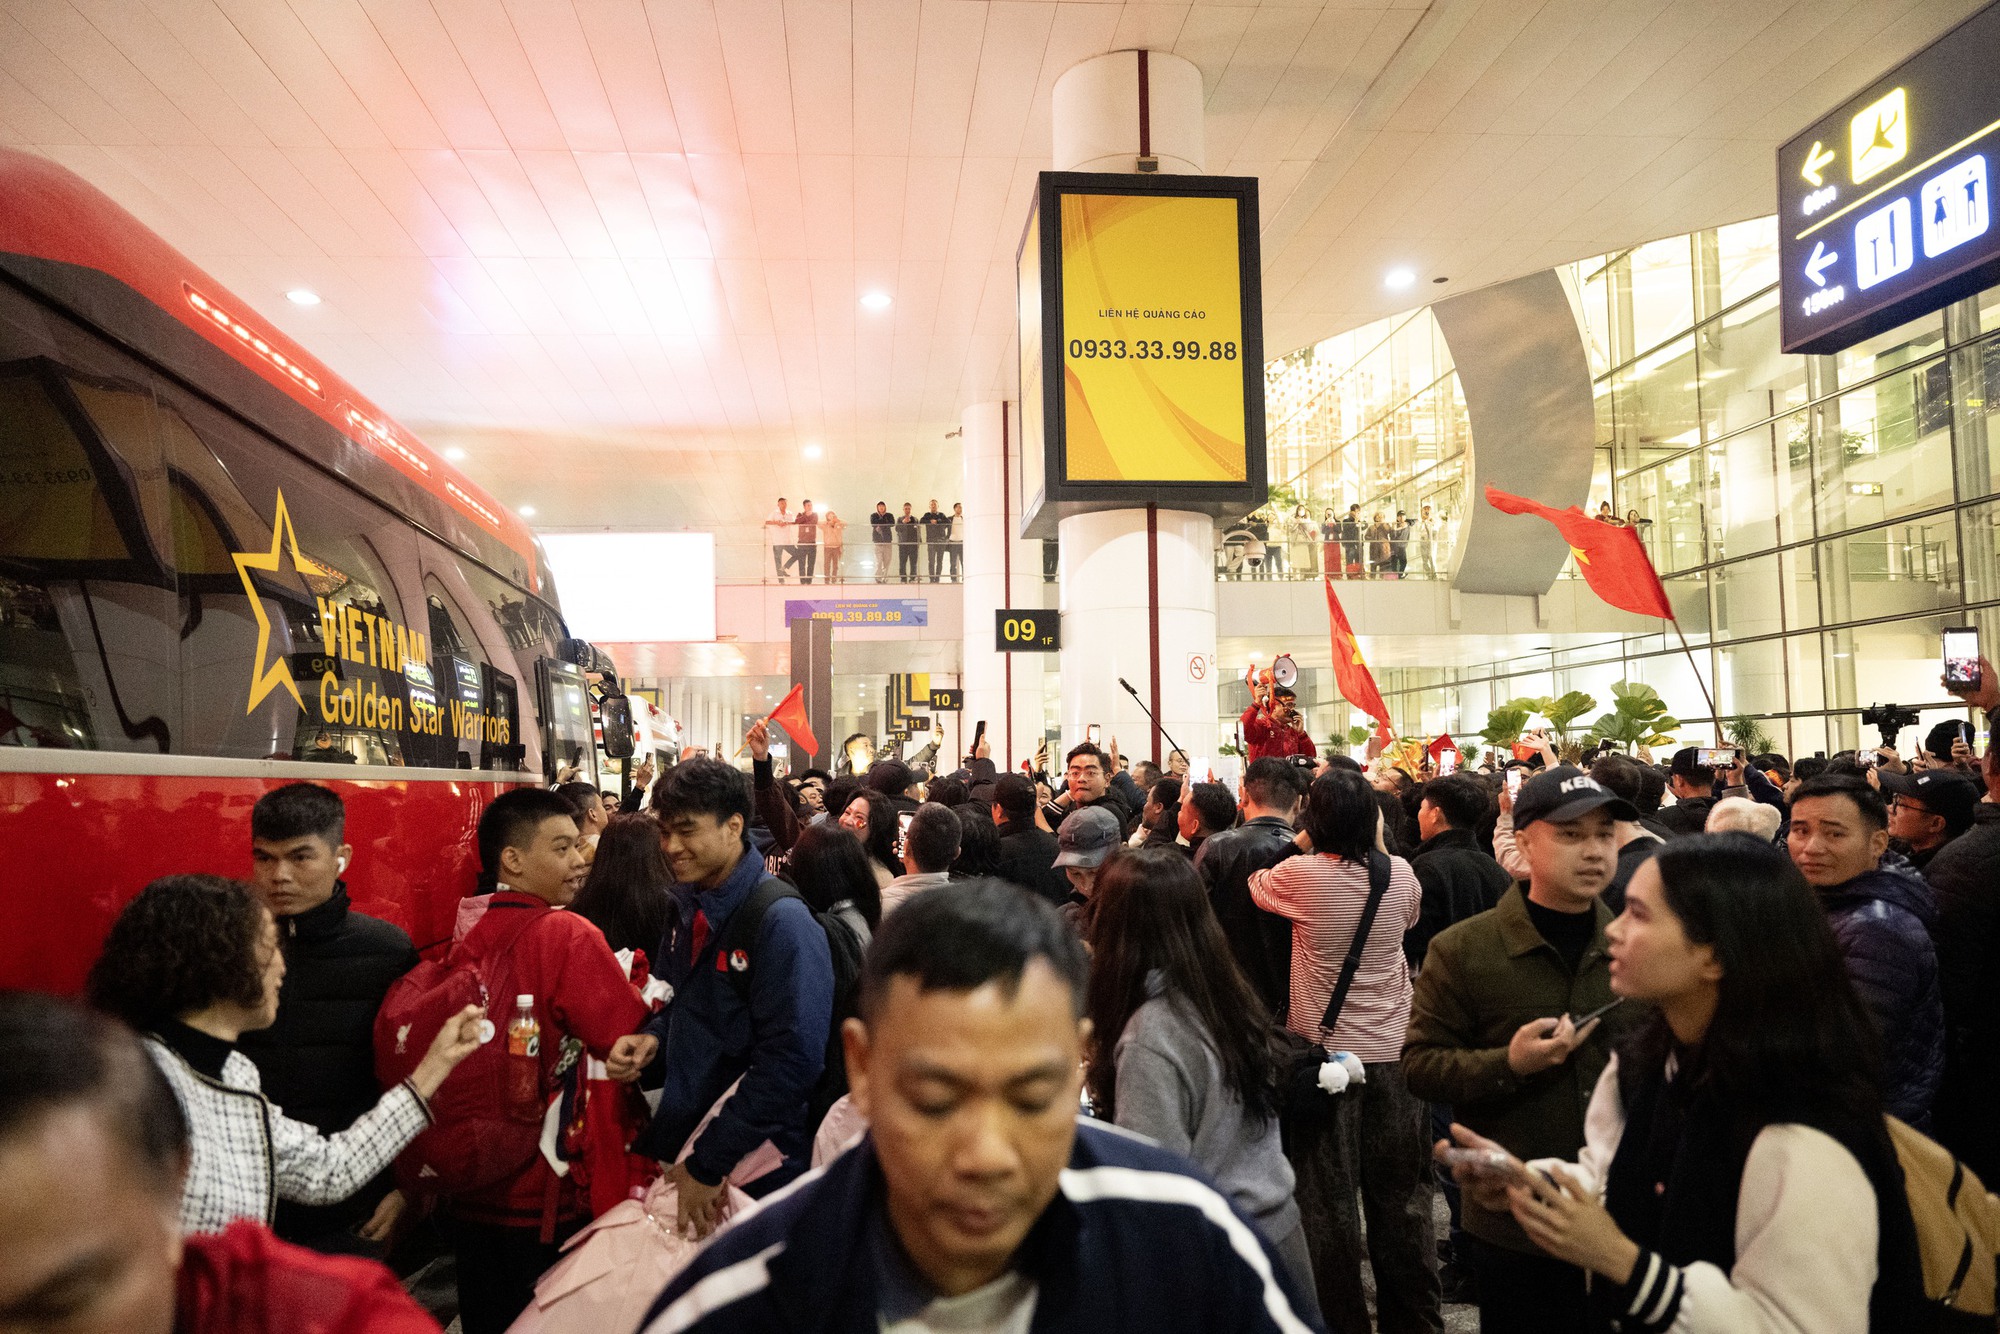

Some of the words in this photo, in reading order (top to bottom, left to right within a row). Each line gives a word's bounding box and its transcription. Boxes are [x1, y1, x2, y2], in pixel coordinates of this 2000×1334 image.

[1098, 308, 1122, 318] LIÊN
[1125, 308, 1140, 320] HỆ
[1143, 307, 1180, 319] QUẢNG
[1183, 308, 1206, 320] CÁO
[1069, 339, 1237, 361] 0933.33.99.88
[316, 596, 427, 674] VIETNAM
[1003, 618, 1036, 641] 09
[1041, 636, 1053, 645] 1F
[320, 670, 403, 731] Golden
[409, 692, 445, 736] Star
[449, 698, 510, 745] Warriors
[933, 693, 951, 706] 10
[909, 719, 921, 728] 11
[896, 732, 906, 740] 12
